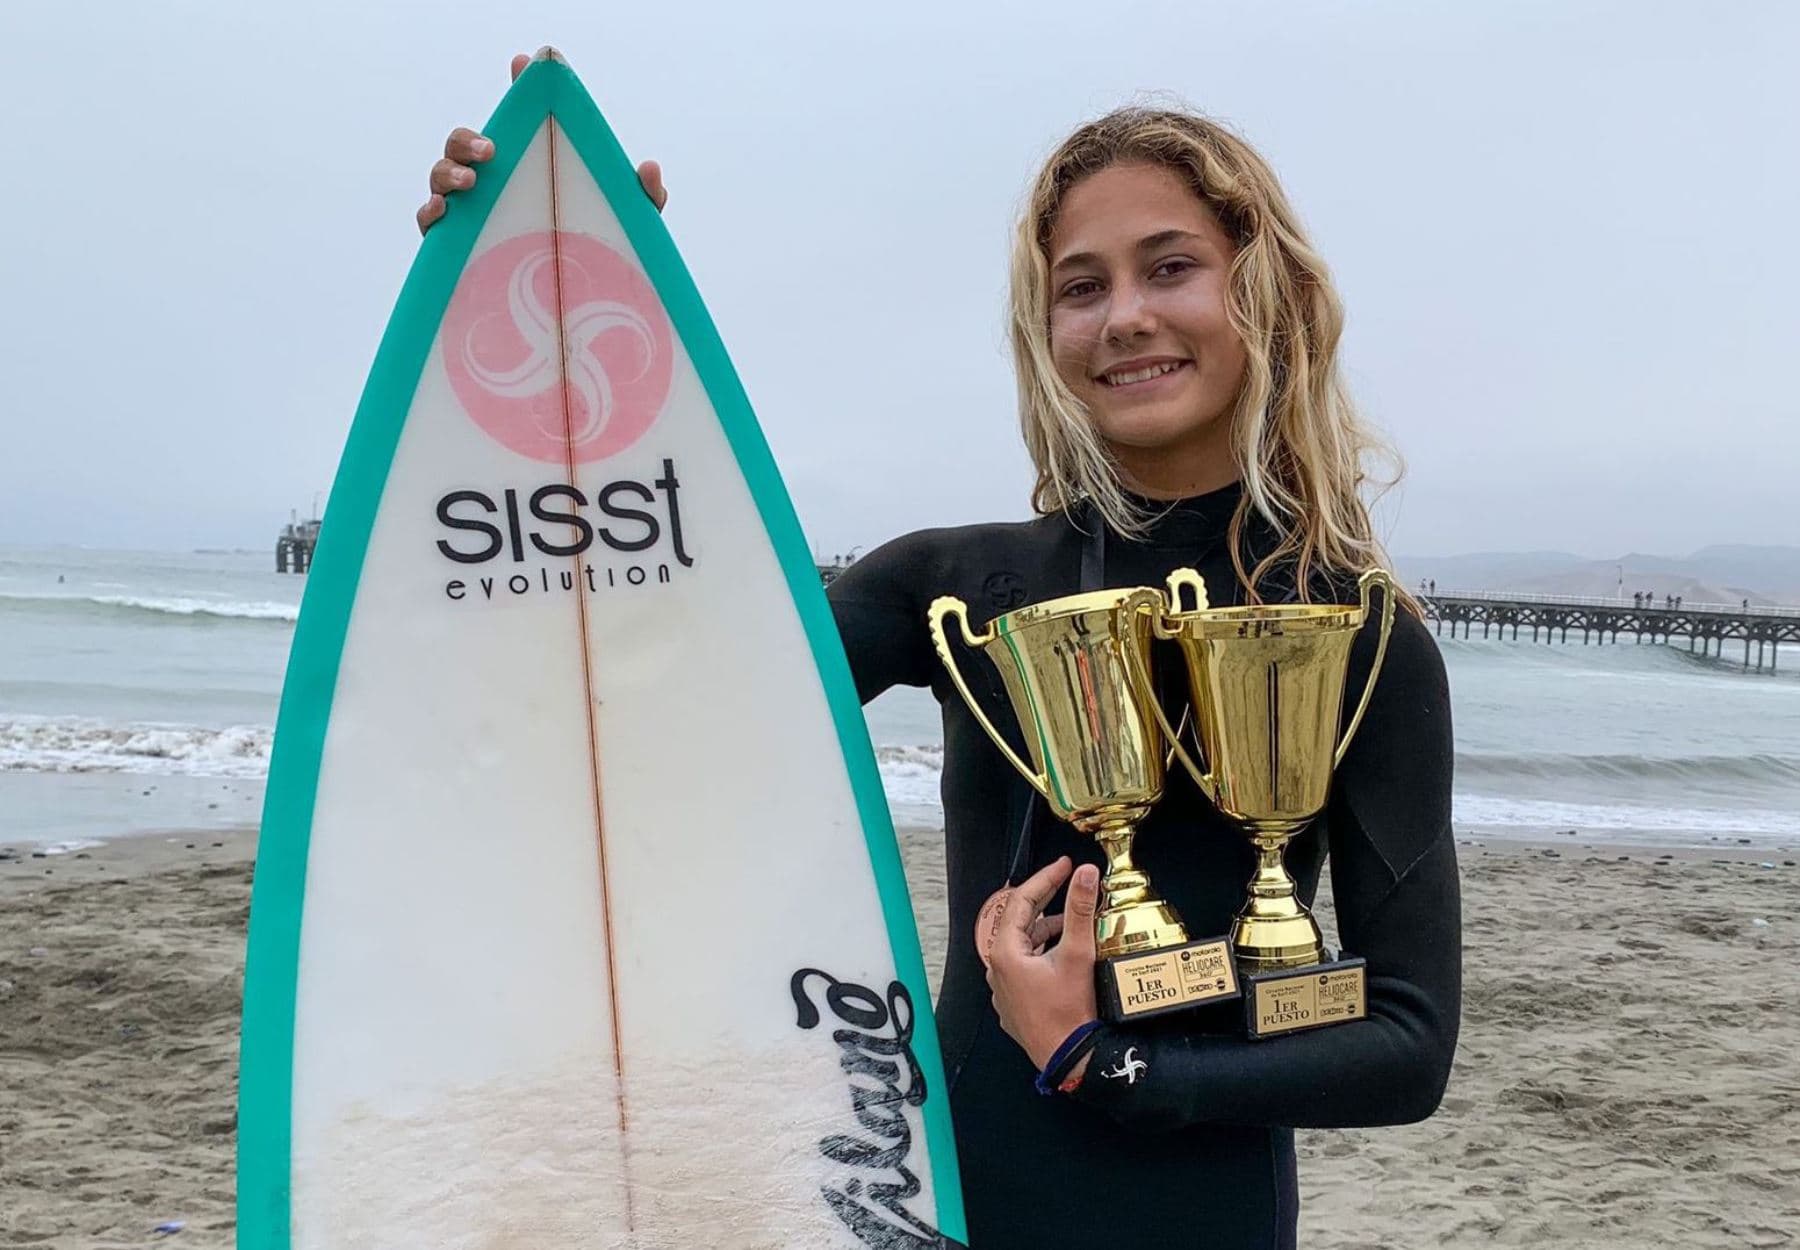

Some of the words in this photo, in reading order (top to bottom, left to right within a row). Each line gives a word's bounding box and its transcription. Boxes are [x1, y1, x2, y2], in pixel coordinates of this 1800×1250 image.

[446, 564, 670, 600] evolution
[1182, 956, 1225, 974] HELIOCARE
[1136, 978, 1163, 993] 1ER
[1319, 981, 1359, 997] HELIOCARE
[1127, 987, 1177, 1006] PUESTO
[1274, 999, 1298, 1014] 1ER
[1263, 1010, 1310, 1026] PUESTO
